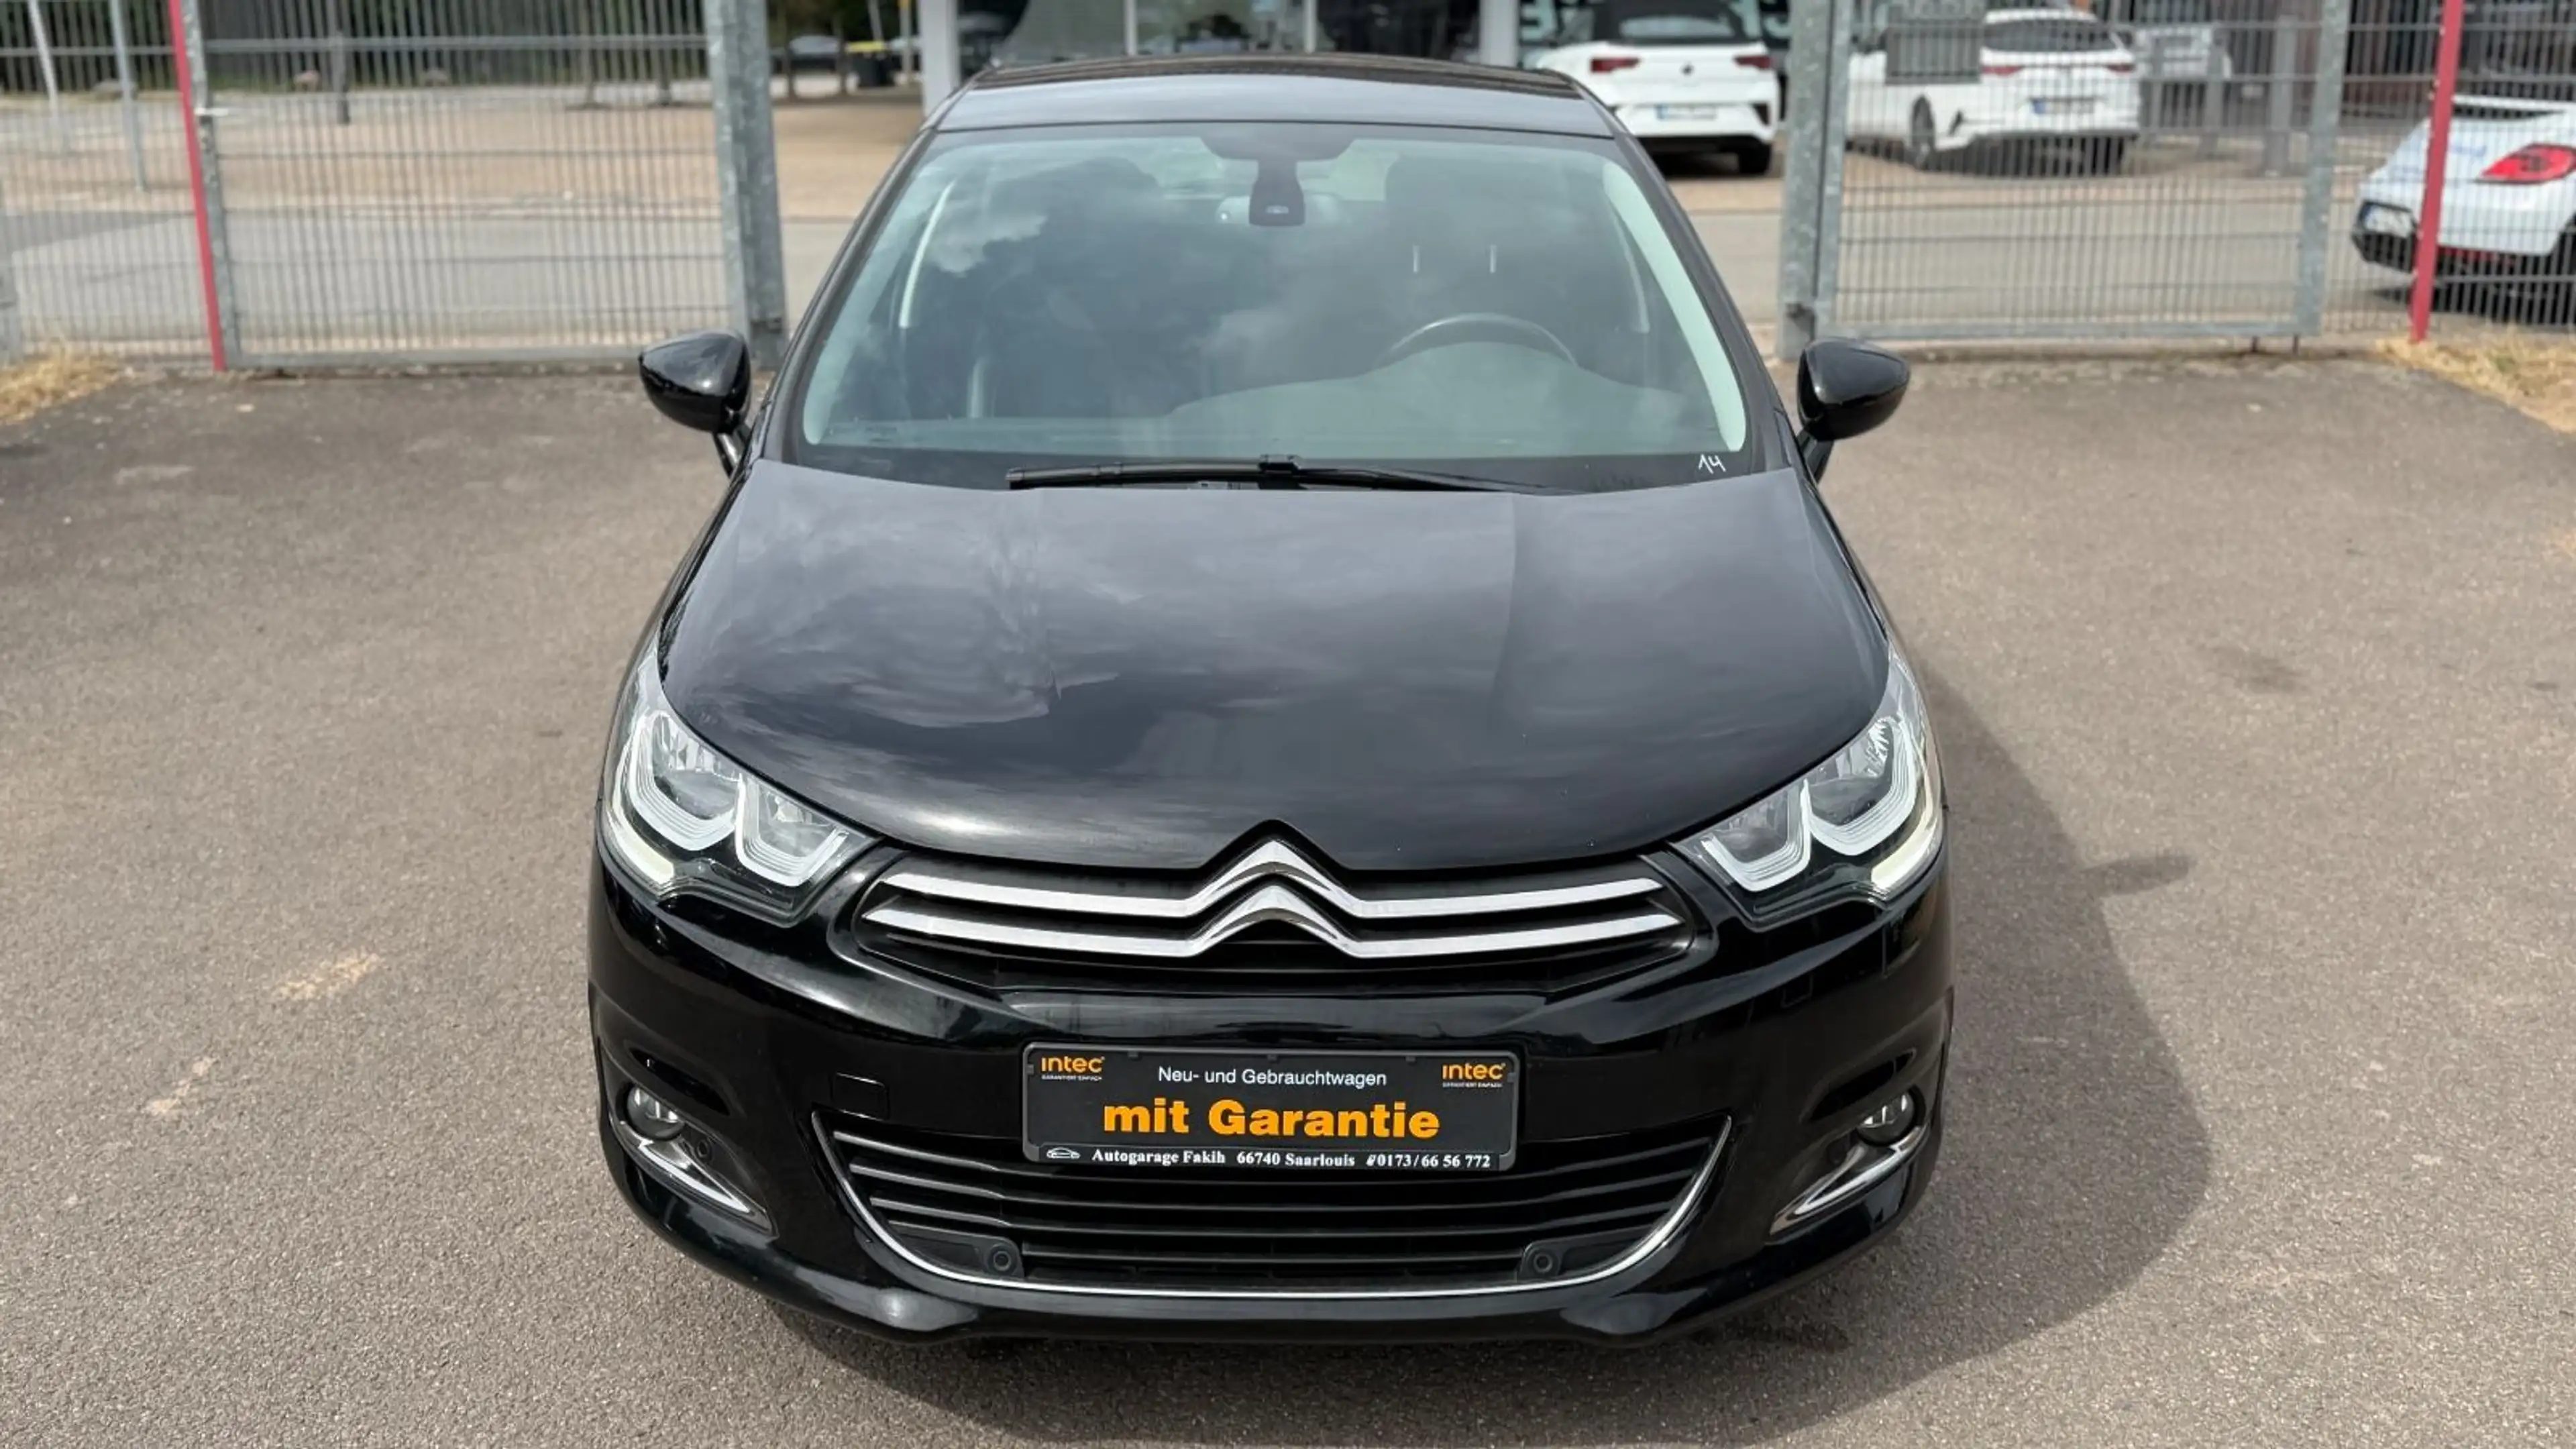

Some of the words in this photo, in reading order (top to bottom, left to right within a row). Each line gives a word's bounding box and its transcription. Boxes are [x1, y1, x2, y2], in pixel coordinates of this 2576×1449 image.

[1698, 453, 1727, 474] 14
[1158, 1067, 1199, 1082] Neu-
[1205, 1069, 1236, 1083] und
[1242, 1069, 1387, 1089] Gebrauchtwagen
[1104, 1097, 1189, 1134] mit
[1208, 1099, 1440, 1138] Garantie
[1091, 1148, 1179, 1166] Autogarage
[1183, 1150, 1226, 1164] Fakih
[1236, 1151, 1281, 1165] 66740
[1285, 1153, 1355, 1167] Saarlouis
[1442, 1155, 1460, 1168] 56
[1465, 1155, 1491, 1168] 772
